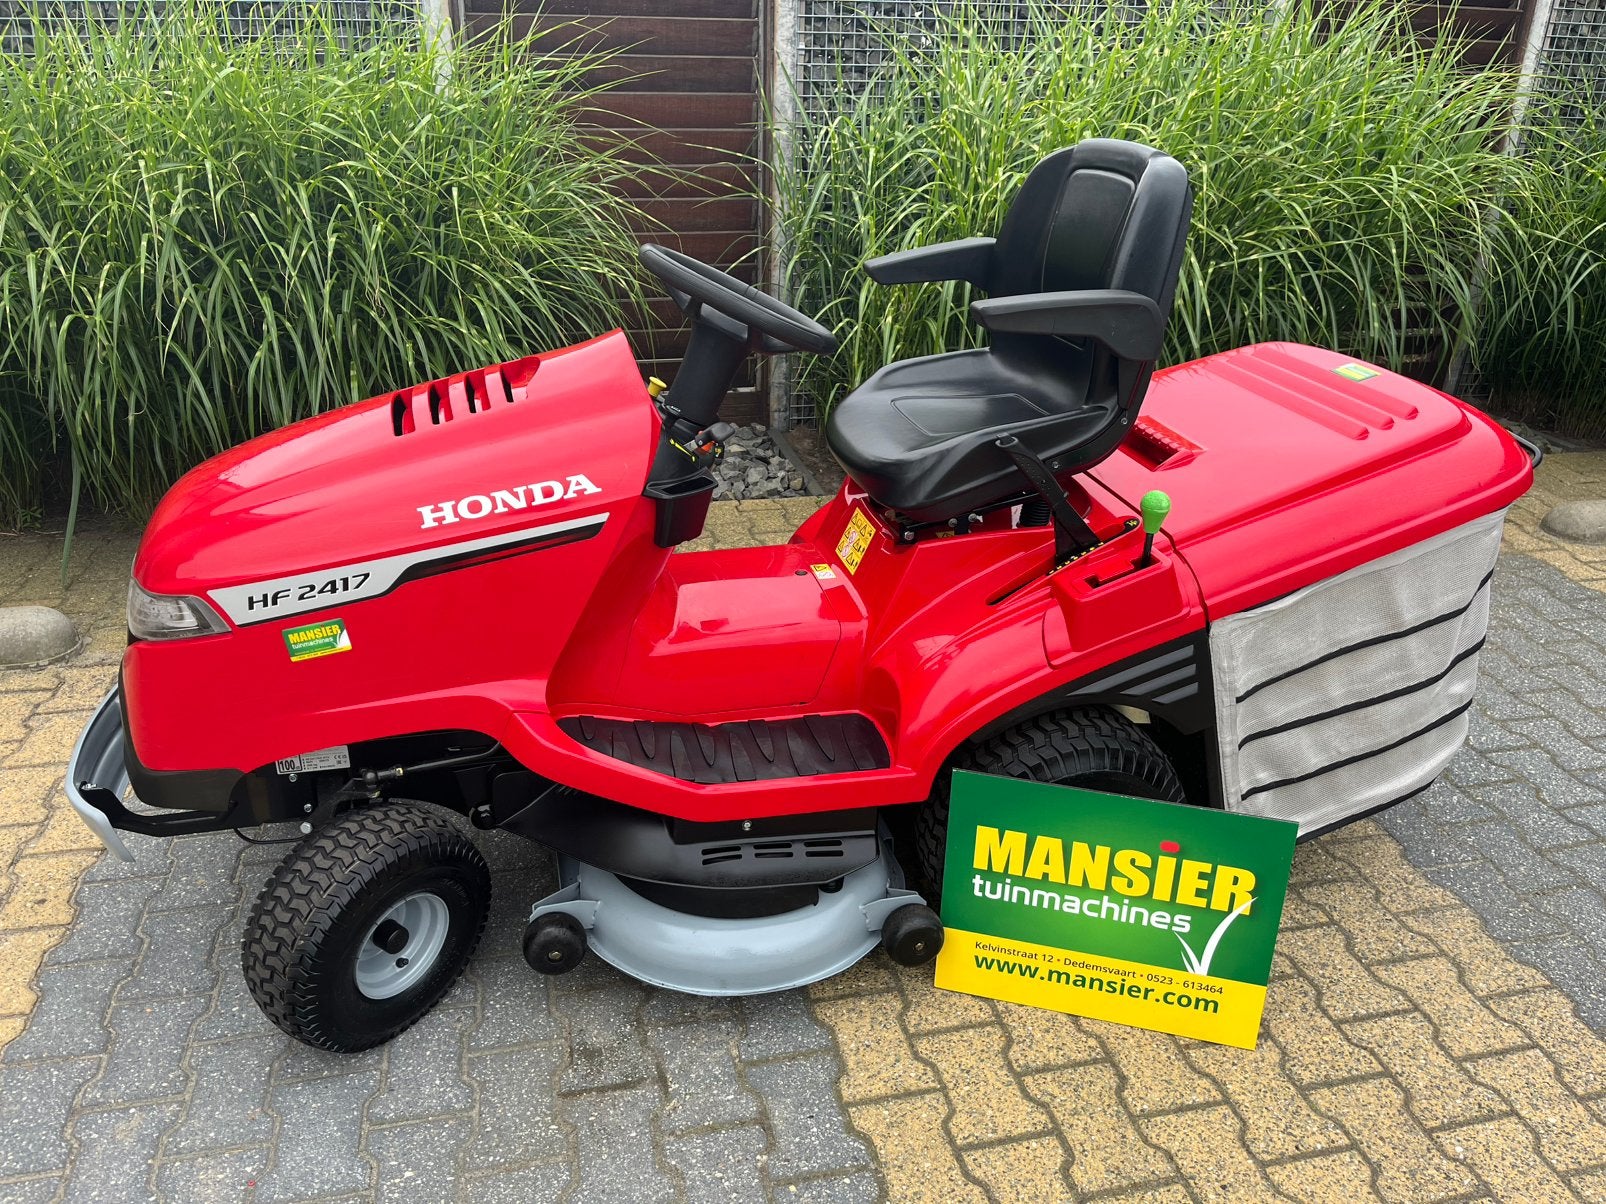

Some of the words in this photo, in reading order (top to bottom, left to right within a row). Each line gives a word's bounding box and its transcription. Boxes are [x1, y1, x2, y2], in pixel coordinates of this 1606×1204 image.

[417, 473, 602, 529] HONDA
[247, 588, 292, 611] HF
[297, 572, 371, 602] 2417
[288, 624, 341, 645] MANSIER
[291, 637, 334, 650] tuinmachines
[279, 759, 295, 772] 100
[972, 824, 1257, 916] MANSIER
[972, 874, 1192, 934] tuinmachines
[974, 941, 1038, 961] Kelvinstraat
[1041, 953, 1055, 964] 12
[1063, 957, 1137, 979] Dedemsvaart
[1146, 973, 1174, 986] 0523
[1182, 979, 1224, 995] 613464
[974, 954, 1220, 1014] www.mansier.com
